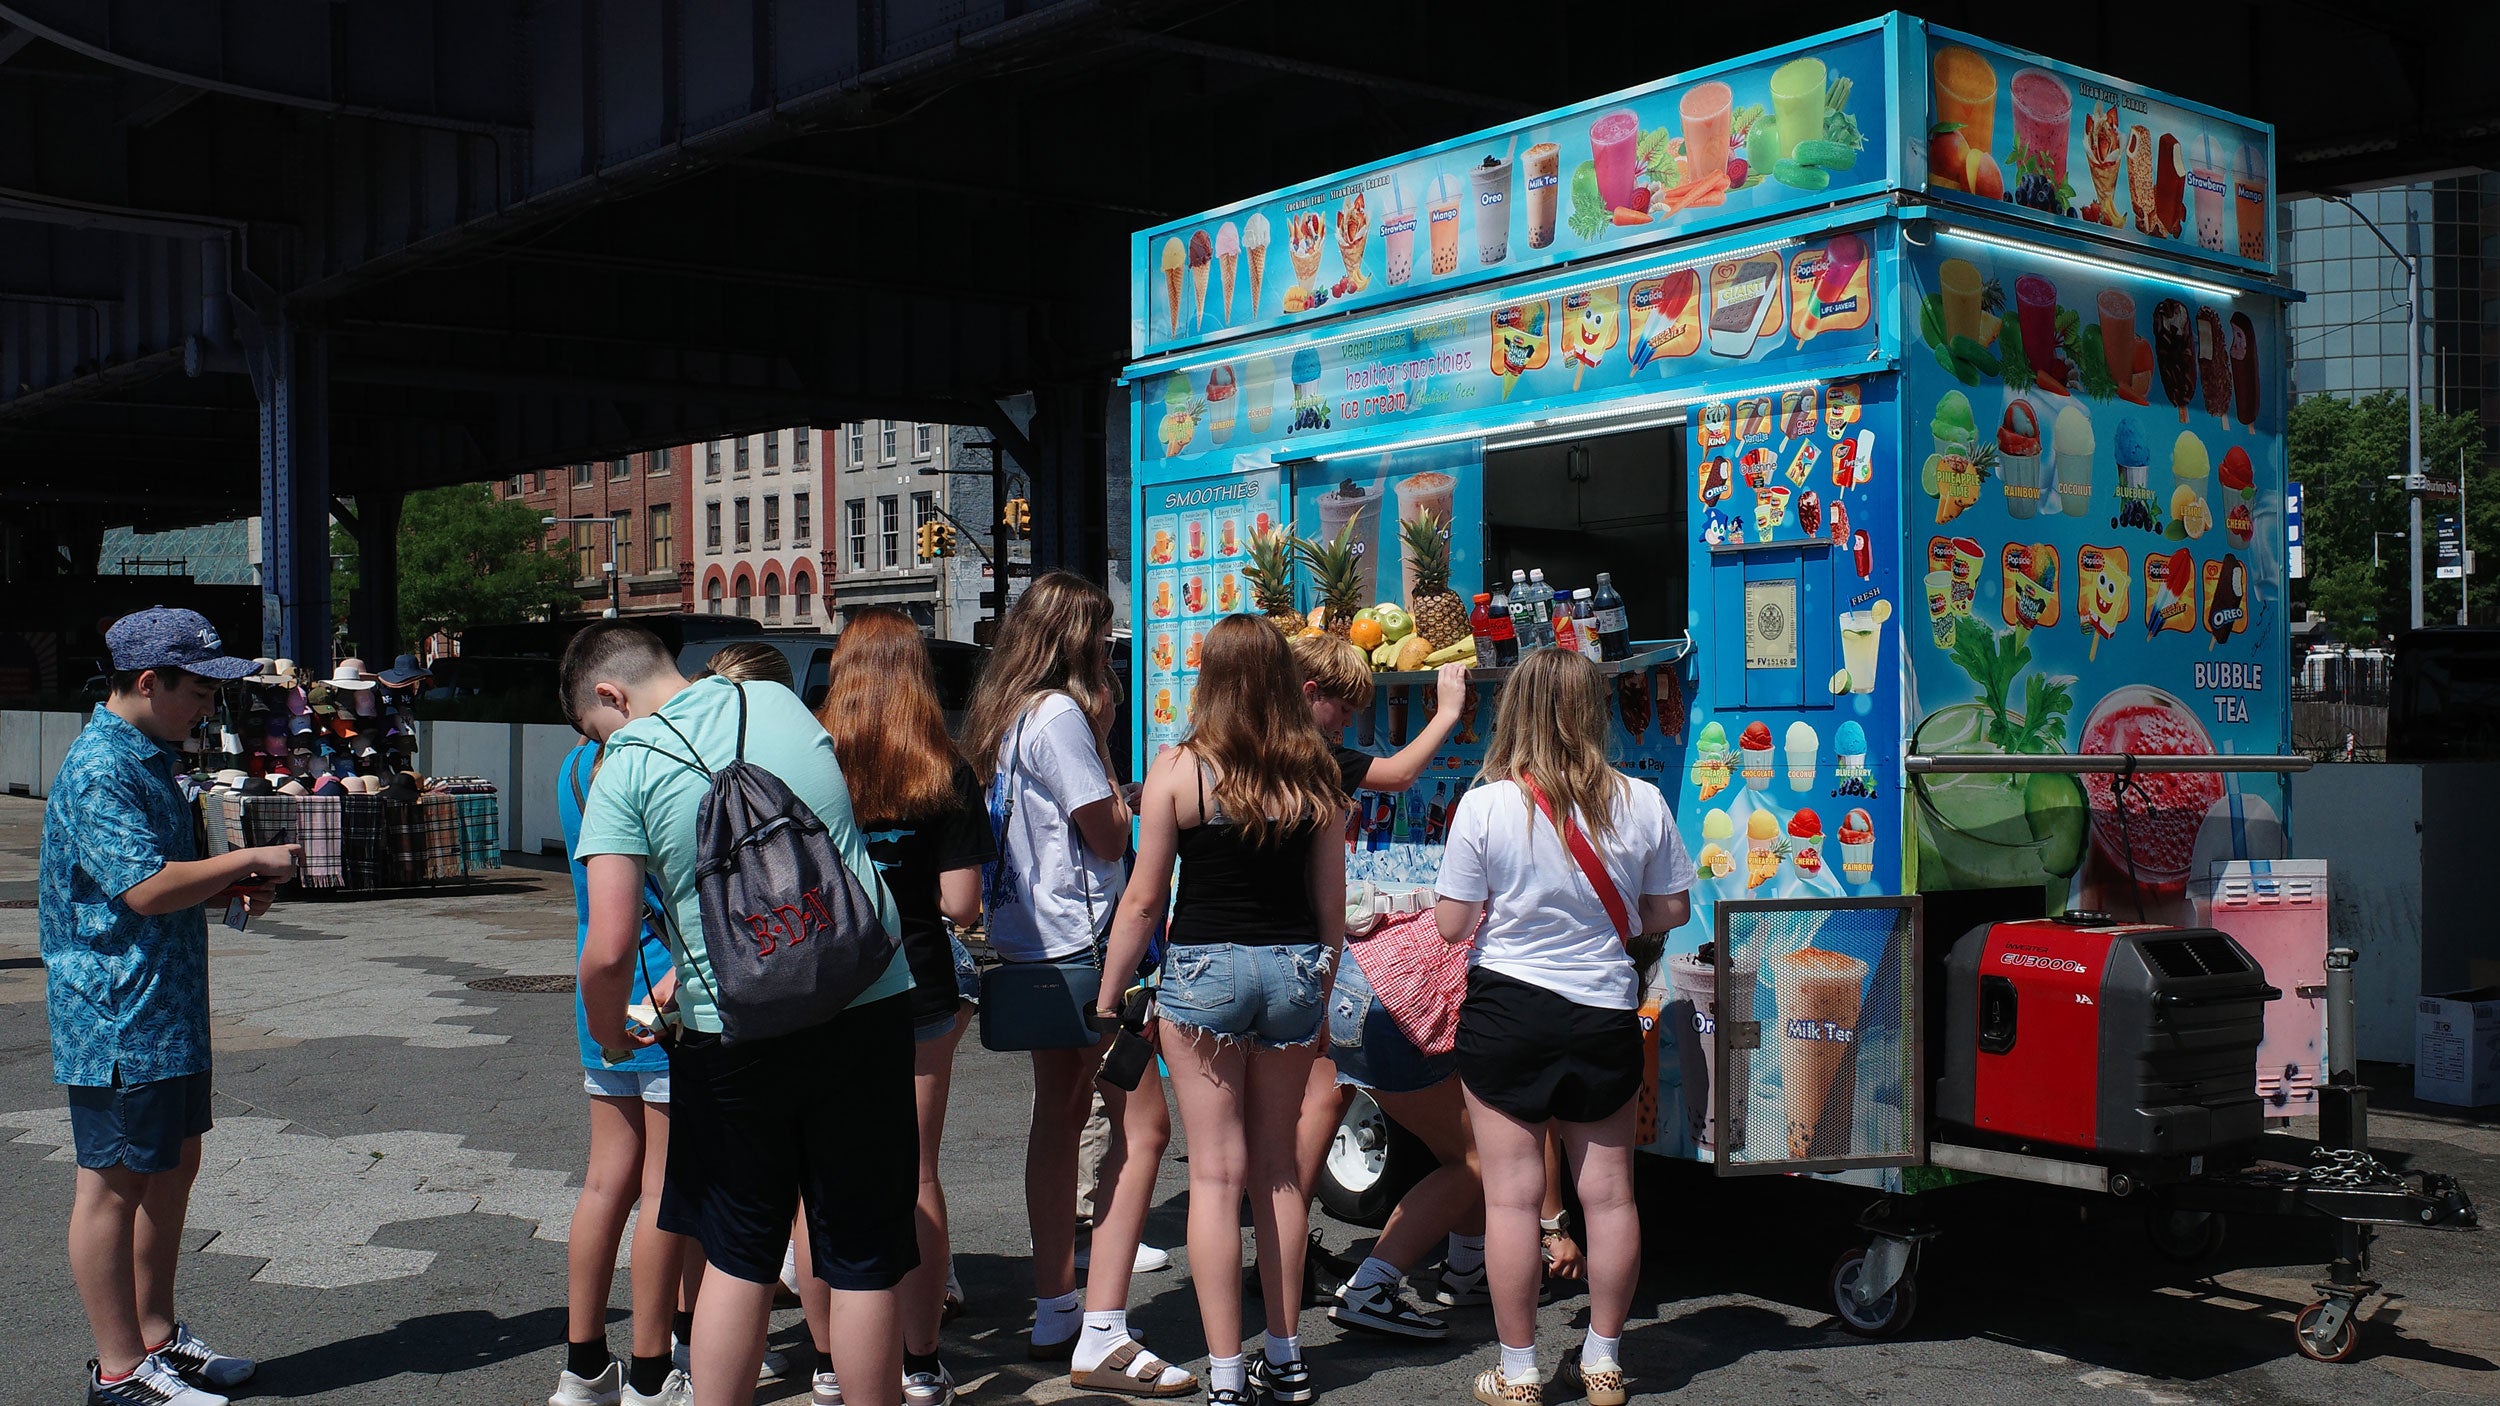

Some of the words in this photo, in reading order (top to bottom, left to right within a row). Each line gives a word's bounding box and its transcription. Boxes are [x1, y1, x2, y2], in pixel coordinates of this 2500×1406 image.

[1528, 178, 1544, 190] Milk
[2187, 171, 2227, 196] Strawberry
[1481, 192, 1504, 207] Oreo
[2238, 187, 2263, 202] Mango
[1432, 208, 1458, 223] Mango
[1379, 219, 1416, 237] Strawberry
[1722, 281, 1762, 300] GIANT
[1635, 292, 1663, 305] Popsicle
[1341, 337, 1373, 361] veggie
[1375, 332, 1407, 357] juices
[1345, 362, 1395, 390] healthy
[1401, 350, 1473, 381] smoothies
[1340, 397, 1359, 419] ice
[1364, 391, 1407, 416] cream
[1708, 436, 1727, 446] KING
[1741, 462, 1777, 475] Outshine
[1936, 471, 1980, 487] PINEAPPLE
[1165, 481, 1259, 509] SMOOTHIES
[1706, 485, 1728, 498] OREO
[1949, 484, 1969, 498] LIME
[2003, 484, 2041, 499] RAINBOW
[2058, 483, 2092, 496] COCONUT
[2115, 486, 2155, 500] BLUEBERRY
[2426, 481, 2447, 495] Burling
[2447, 482, 2458, 495] Slip
[2226, 518, 2251, 530] CHERRY
[2008, 555, 2031, 565] Popsicle
[1851, 587, 1881, 606] FRESH
[2214, 608, 2243, 626] OREO
[2194, 662, 2263, 691] BUBBLE
[2214, 696, 2249, 723] TEA
[1648, 758, 1665, 773] Pay
[1700, 769, 1730, 777] PINEAPPLE
[1788, 770, 1816, 778] COCONUT
[1835, 769, 1872, 777] BLUEBERRY
[1708, 857, 1727, 865] LEMON
[1748, 857, 1780, 865] PINEAPPLE
[1794, 857, 1818, 866] CHERRY
[1843, 863, 1874, 872] RAINBOW
[2000, 953, 2087, 974] EU3000is
[1692, 1012, 1715, 1033] Or
[1787, 1020, 1821, 1039] Milk
[1289, 1363, 1302, 1372] NIKE
[1219, 1391, 1234, 1400] NIKE
